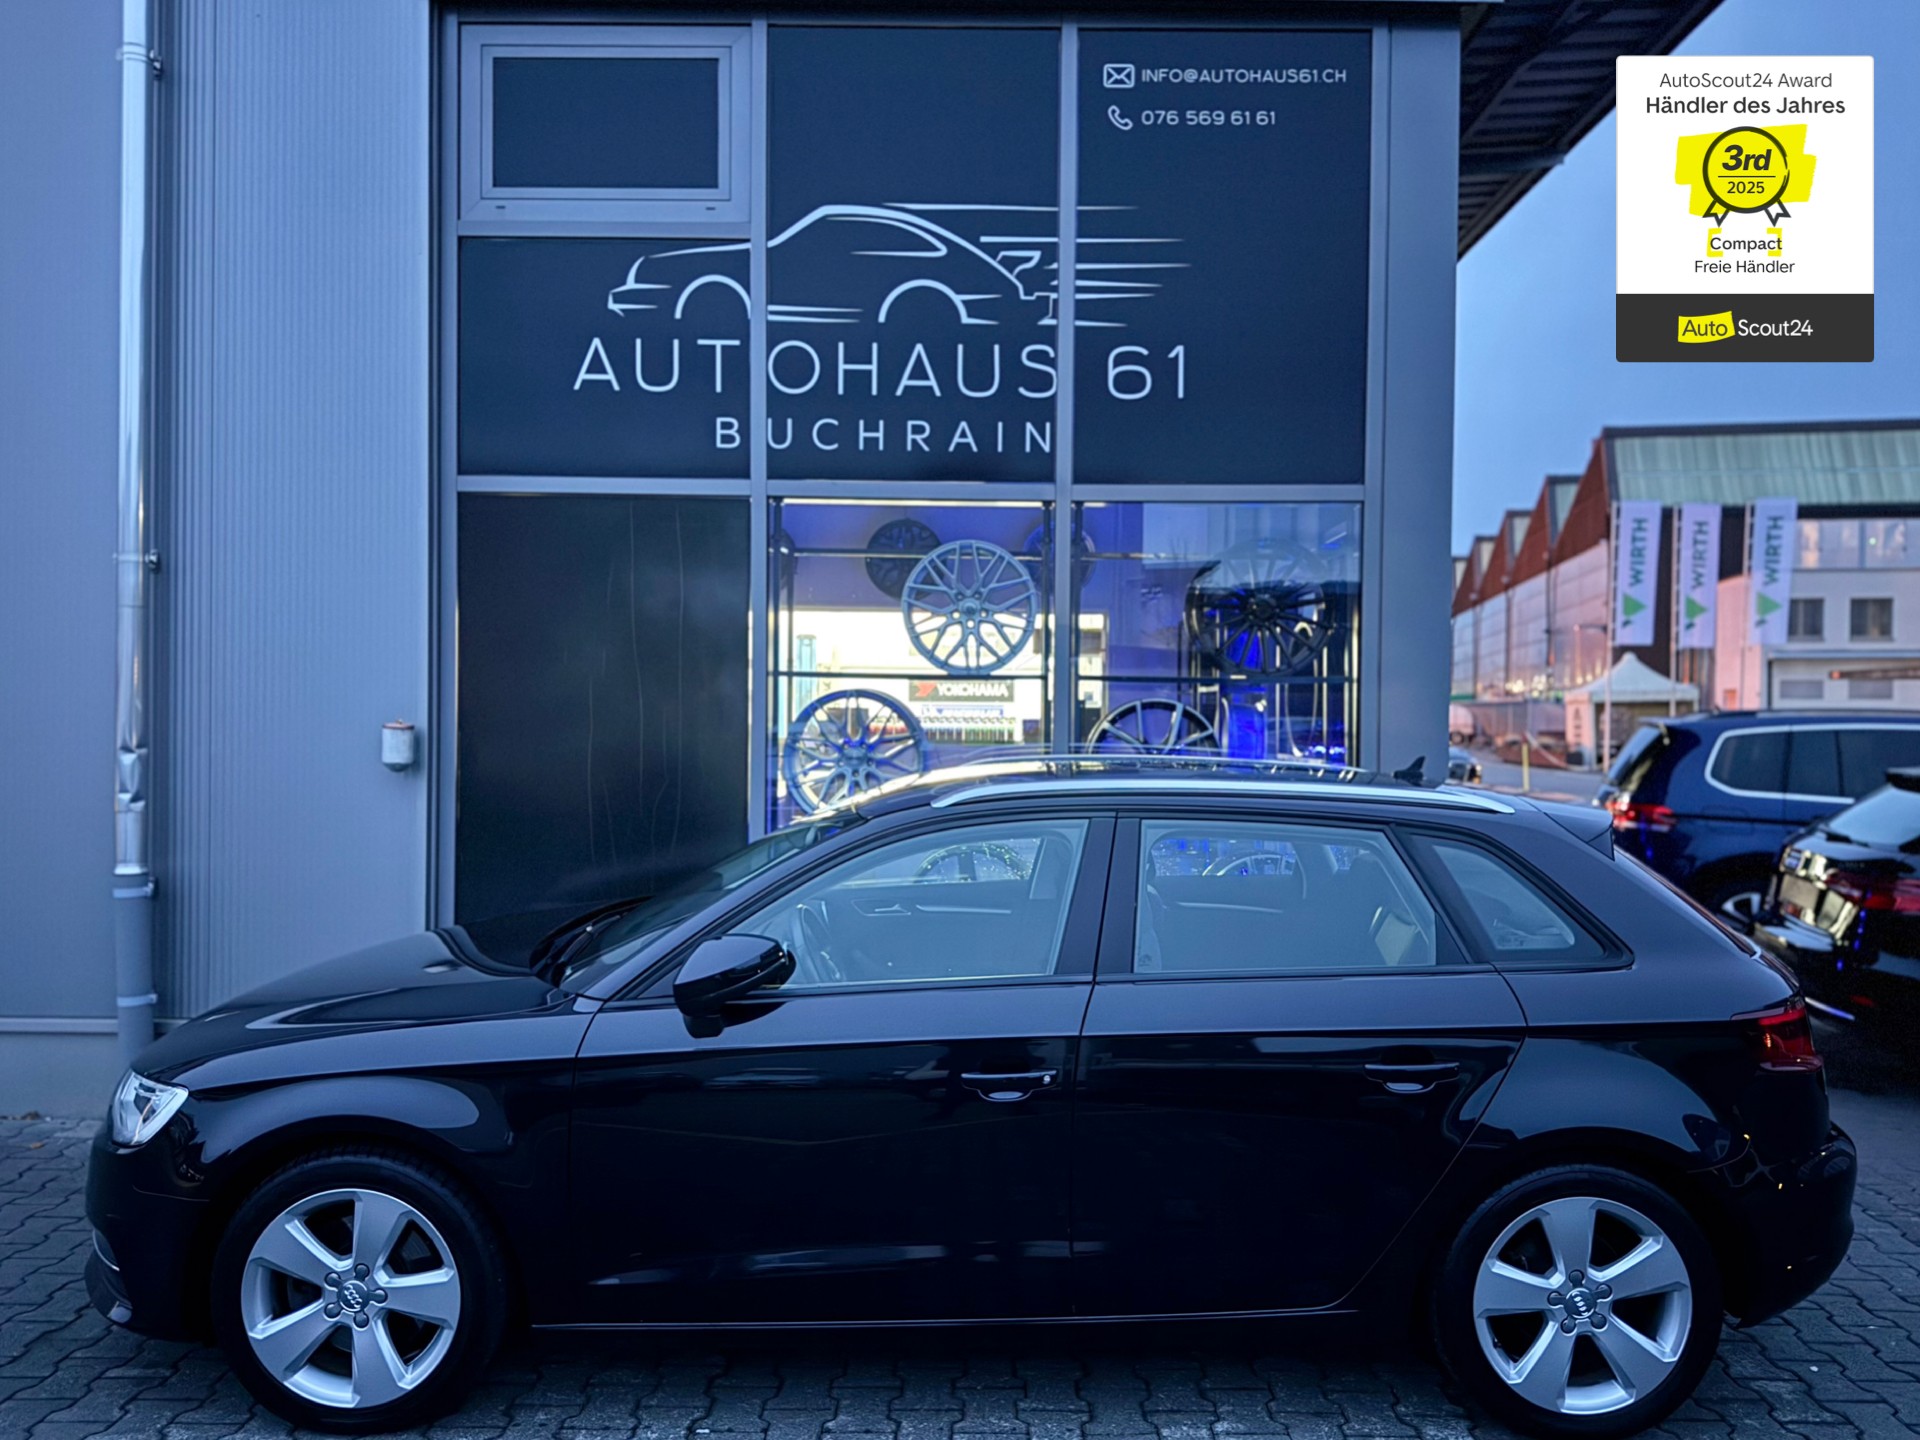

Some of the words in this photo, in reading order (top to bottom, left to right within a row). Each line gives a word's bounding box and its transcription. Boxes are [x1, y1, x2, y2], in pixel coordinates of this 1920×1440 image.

[1141, 68, 1347, 83] INFO@AUTOHAUS61.CH
[1141, 110, 1179, 125] 076
[1185, 110, 1225, 125] 569
[1230, 110, 1250, 125] 61
[1255, 110, 1276, 125] 61
[573, 337, 1058, 399] AUTOHAUS
[1107, 344, 1186, 400] 61
[715, 416, 1052, 453] BUCHRAIN
[1630, 517, 1648, 586] WIRTH
[1692, 521, 1709, 588] WIRTH
[1764, 516, 1784, 586] WIRTH
[936, 682, 1009, 698] YOKOHAMA
